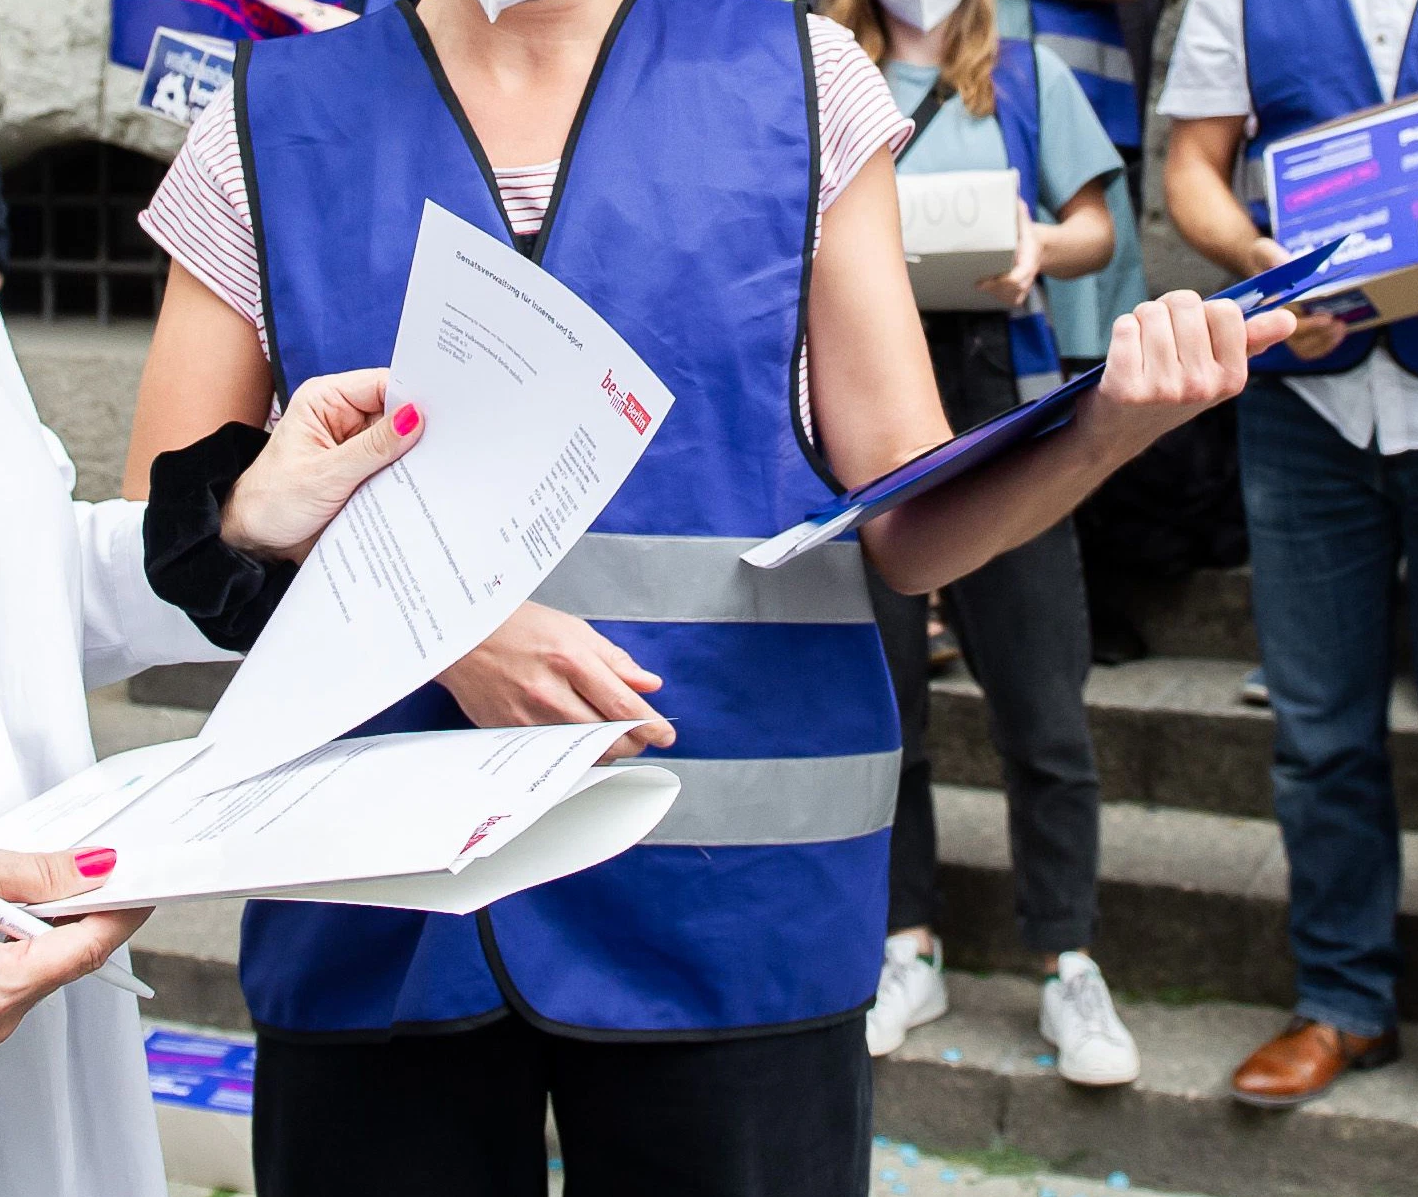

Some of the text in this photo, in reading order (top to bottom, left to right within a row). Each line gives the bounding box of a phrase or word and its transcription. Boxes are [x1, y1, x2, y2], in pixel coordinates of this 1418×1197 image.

[455, 250, 584, 351] Senatsverwaltung für Inneres und Sport
